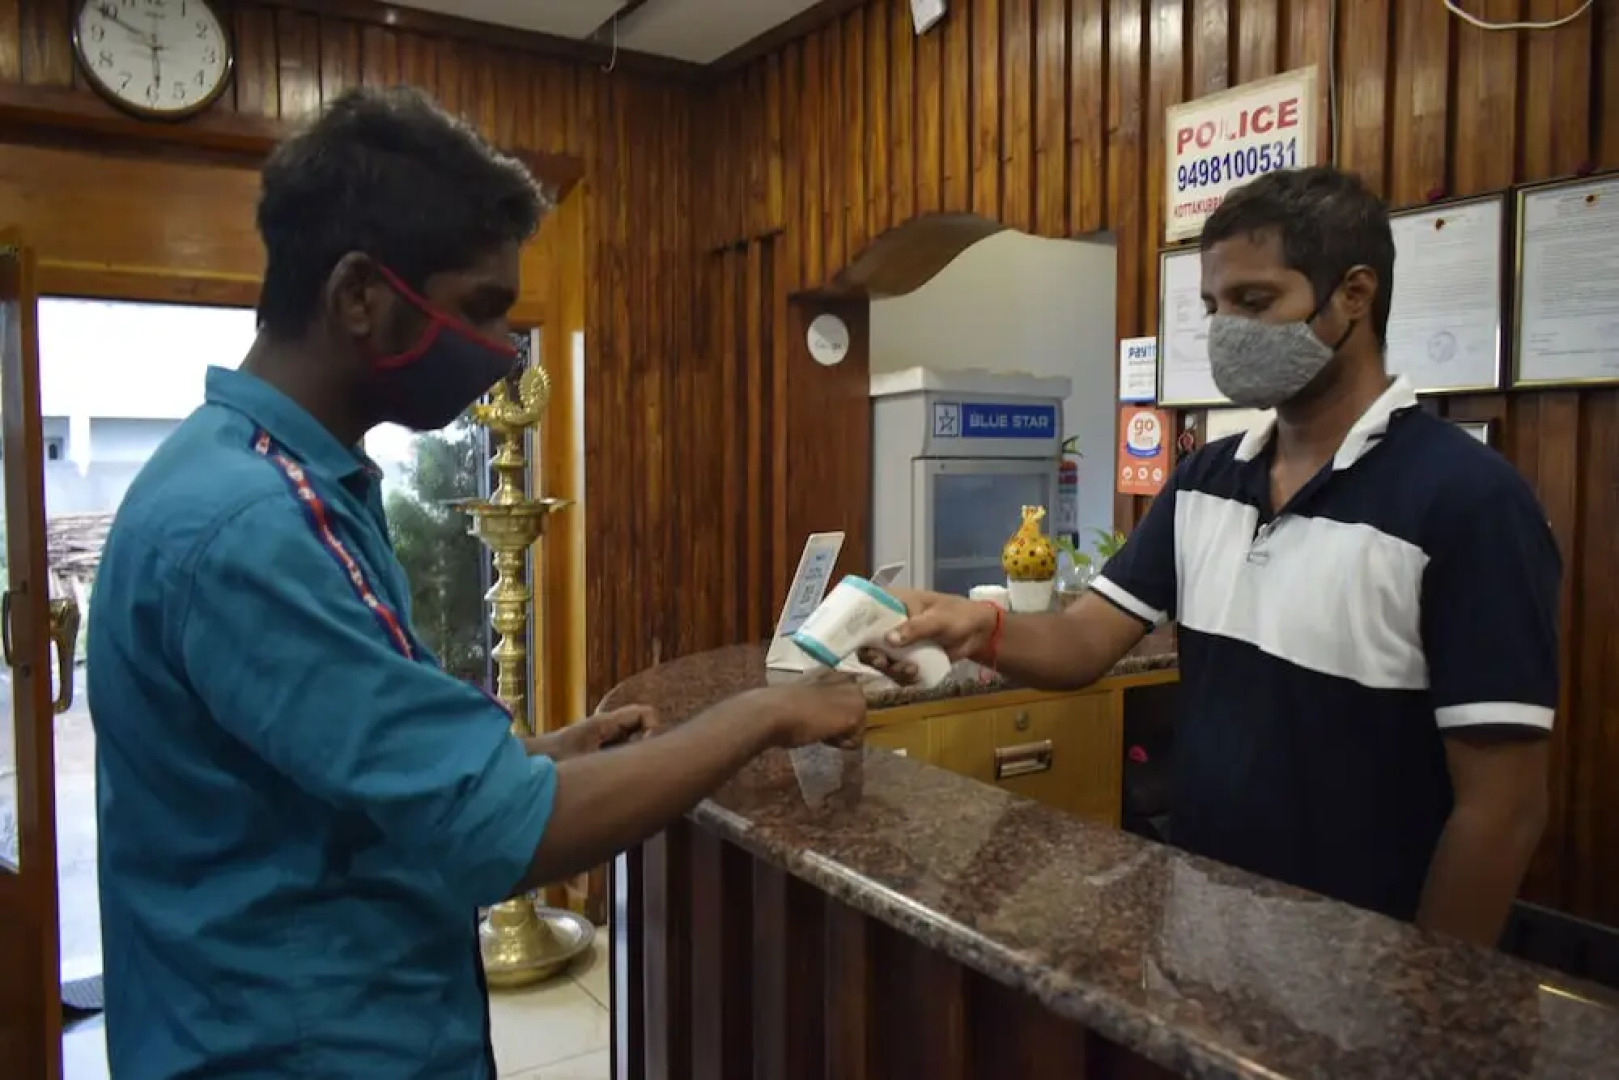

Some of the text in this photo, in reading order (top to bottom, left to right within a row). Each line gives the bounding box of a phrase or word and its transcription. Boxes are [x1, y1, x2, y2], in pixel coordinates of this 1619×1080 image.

[91, 24, 105, 42] 9
[196, 21, 208, 40] 2
[99, 50, 114, 68] 8
[118, 72, 132, 89] 7
[194, 70, 205, 87] 4
[146, 84, 159, 102] 6
[173, 81, 186, 100] 5
[1178, 136, 1297, 192] 9498100531
[969, 413, 1049, 429] BLUE STAR
[1134, 419, 1154, 434] go
